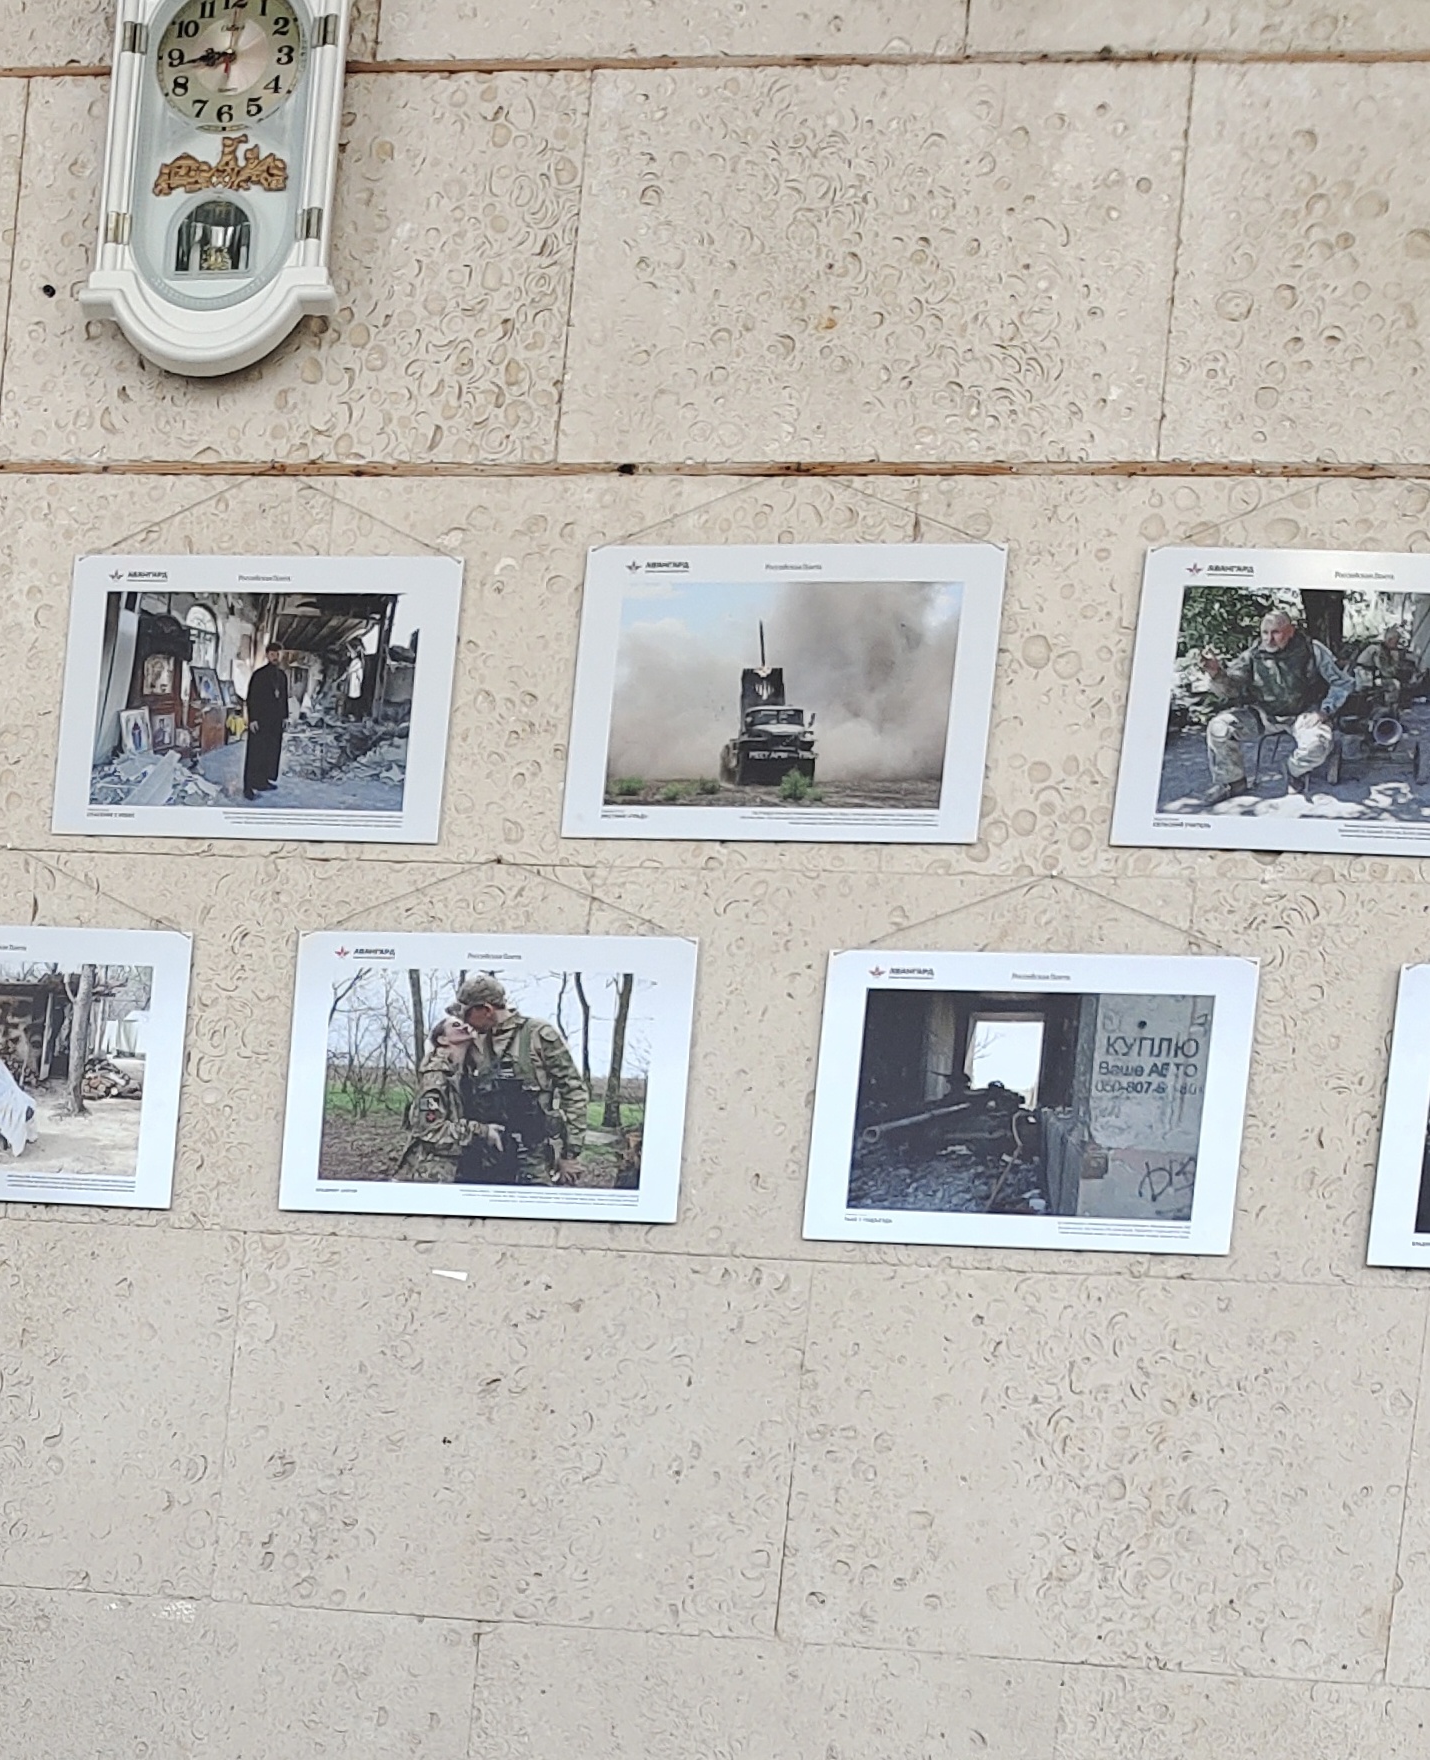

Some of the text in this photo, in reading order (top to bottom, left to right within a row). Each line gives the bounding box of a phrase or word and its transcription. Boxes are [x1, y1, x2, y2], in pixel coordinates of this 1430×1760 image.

[176, 20, 200, 38] 10
[272, 16, 290, 36] 2
[168, 48, 185, 68] 9
[276, 45, 295, 65] 3
[172, 76, 189, 96] 8
[263, 75, 282, 94] 4
[192, 100, 209, 118] 7
[216, 104, 234, 123] 6
[246, 96, 263, 117] 5
[1106, 1035, 1199, 1058] КУПЛЮ
[1099, 1061, 1144, 1077] Ваше
